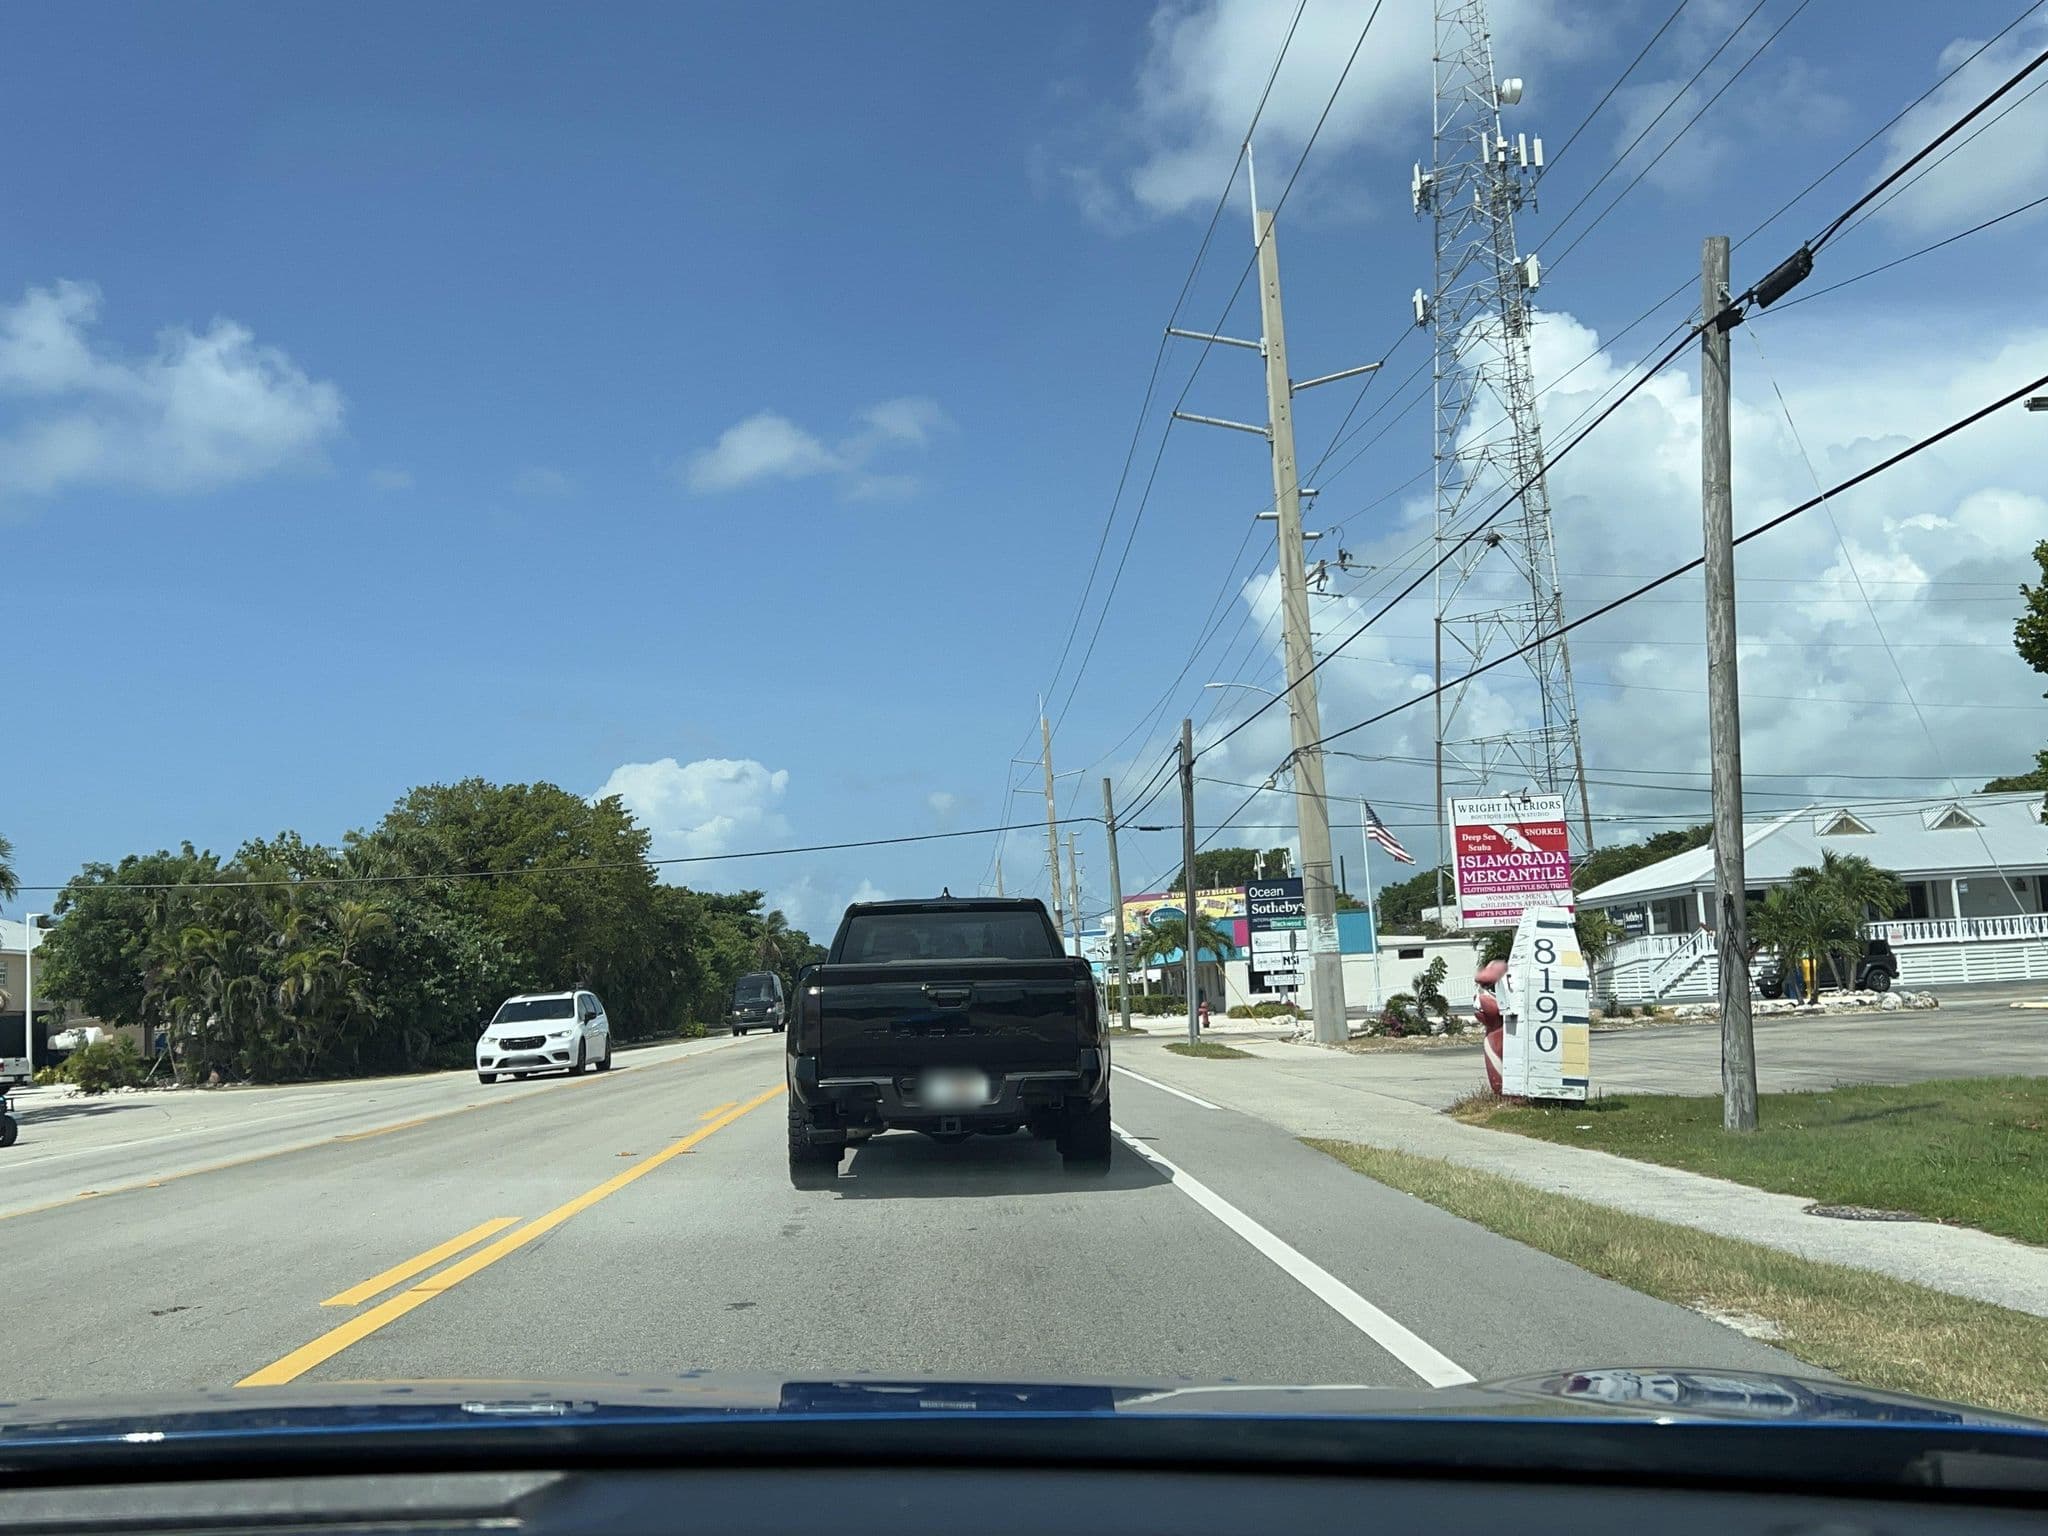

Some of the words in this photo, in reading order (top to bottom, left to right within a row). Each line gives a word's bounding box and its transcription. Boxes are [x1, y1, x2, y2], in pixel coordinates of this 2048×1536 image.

[1458, 803, 1502, 814] WRIGHT
[1504, 800, 1561, 812] INTERIORS
[1462, 833, 1481, 842] Deep
[1482, 832, 1497, 841] Sea
[1524, 827, 1564, 836] SNORKEL
[1468, 844, 1491, 852] Scuba
[1460, 852, 1566, 868] ISLAMORADA
[1462, 867, 1566, 883] MERCANTILE
[1249, 887, 1284, 898] Ocean
[1463, 885, 1496, 894] CLOTHING
[1502, 884, 1535, 892] LIFESTYLE
[1536, 882, 1569, 891] BOUTIQUE
[1251, 901, 1306, 915] Sotheby's
[1524, 899, 1553, 907] APPAREL
[1534, 938, 1558, 1052] 8190
